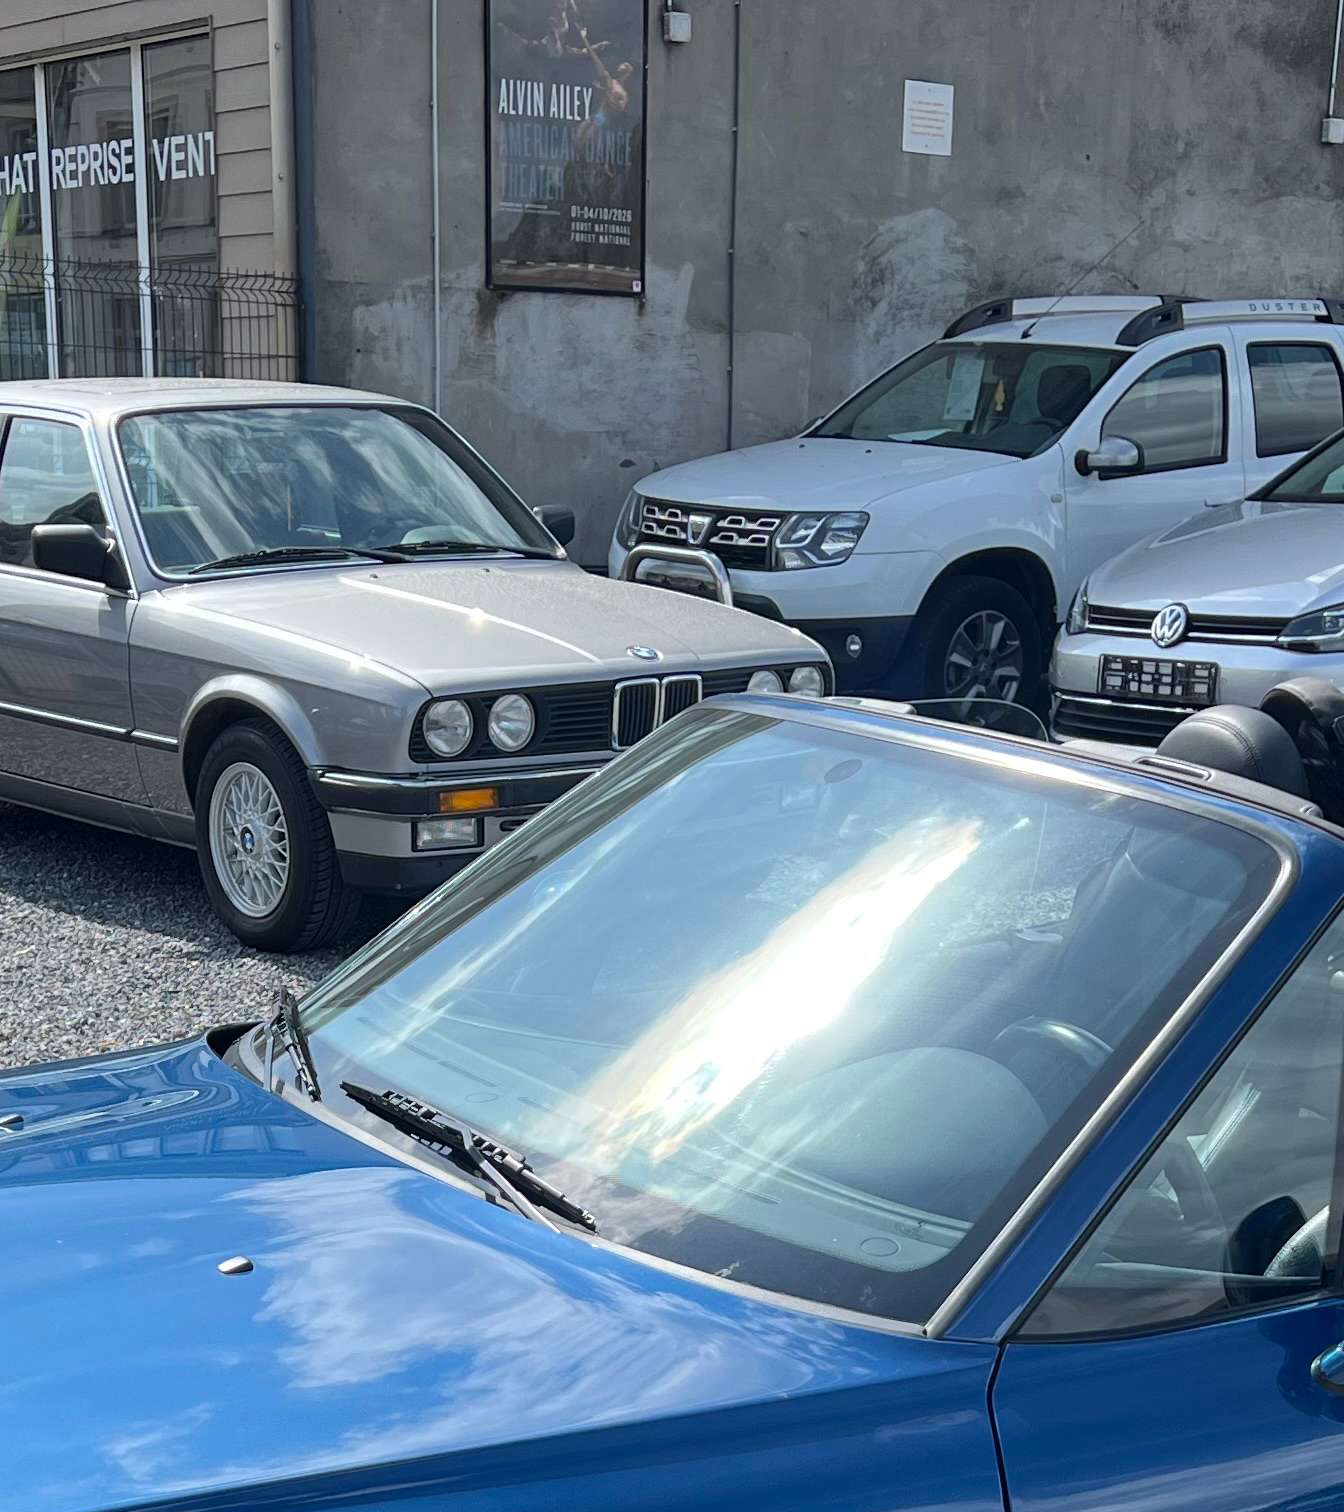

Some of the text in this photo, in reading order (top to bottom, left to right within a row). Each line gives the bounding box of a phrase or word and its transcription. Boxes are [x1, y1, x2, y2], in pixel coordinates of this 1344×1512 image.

[498, 78, 593, 121] ALVIN AILEY
[51, 138, 134, 190] REPRISE
[151, 131, 215, 182] VENT
[586, 128, 633, 166] DANCE
[500, 161, 565, 201] THEATER
[1248, 302, 1322, 312] DUSTER
